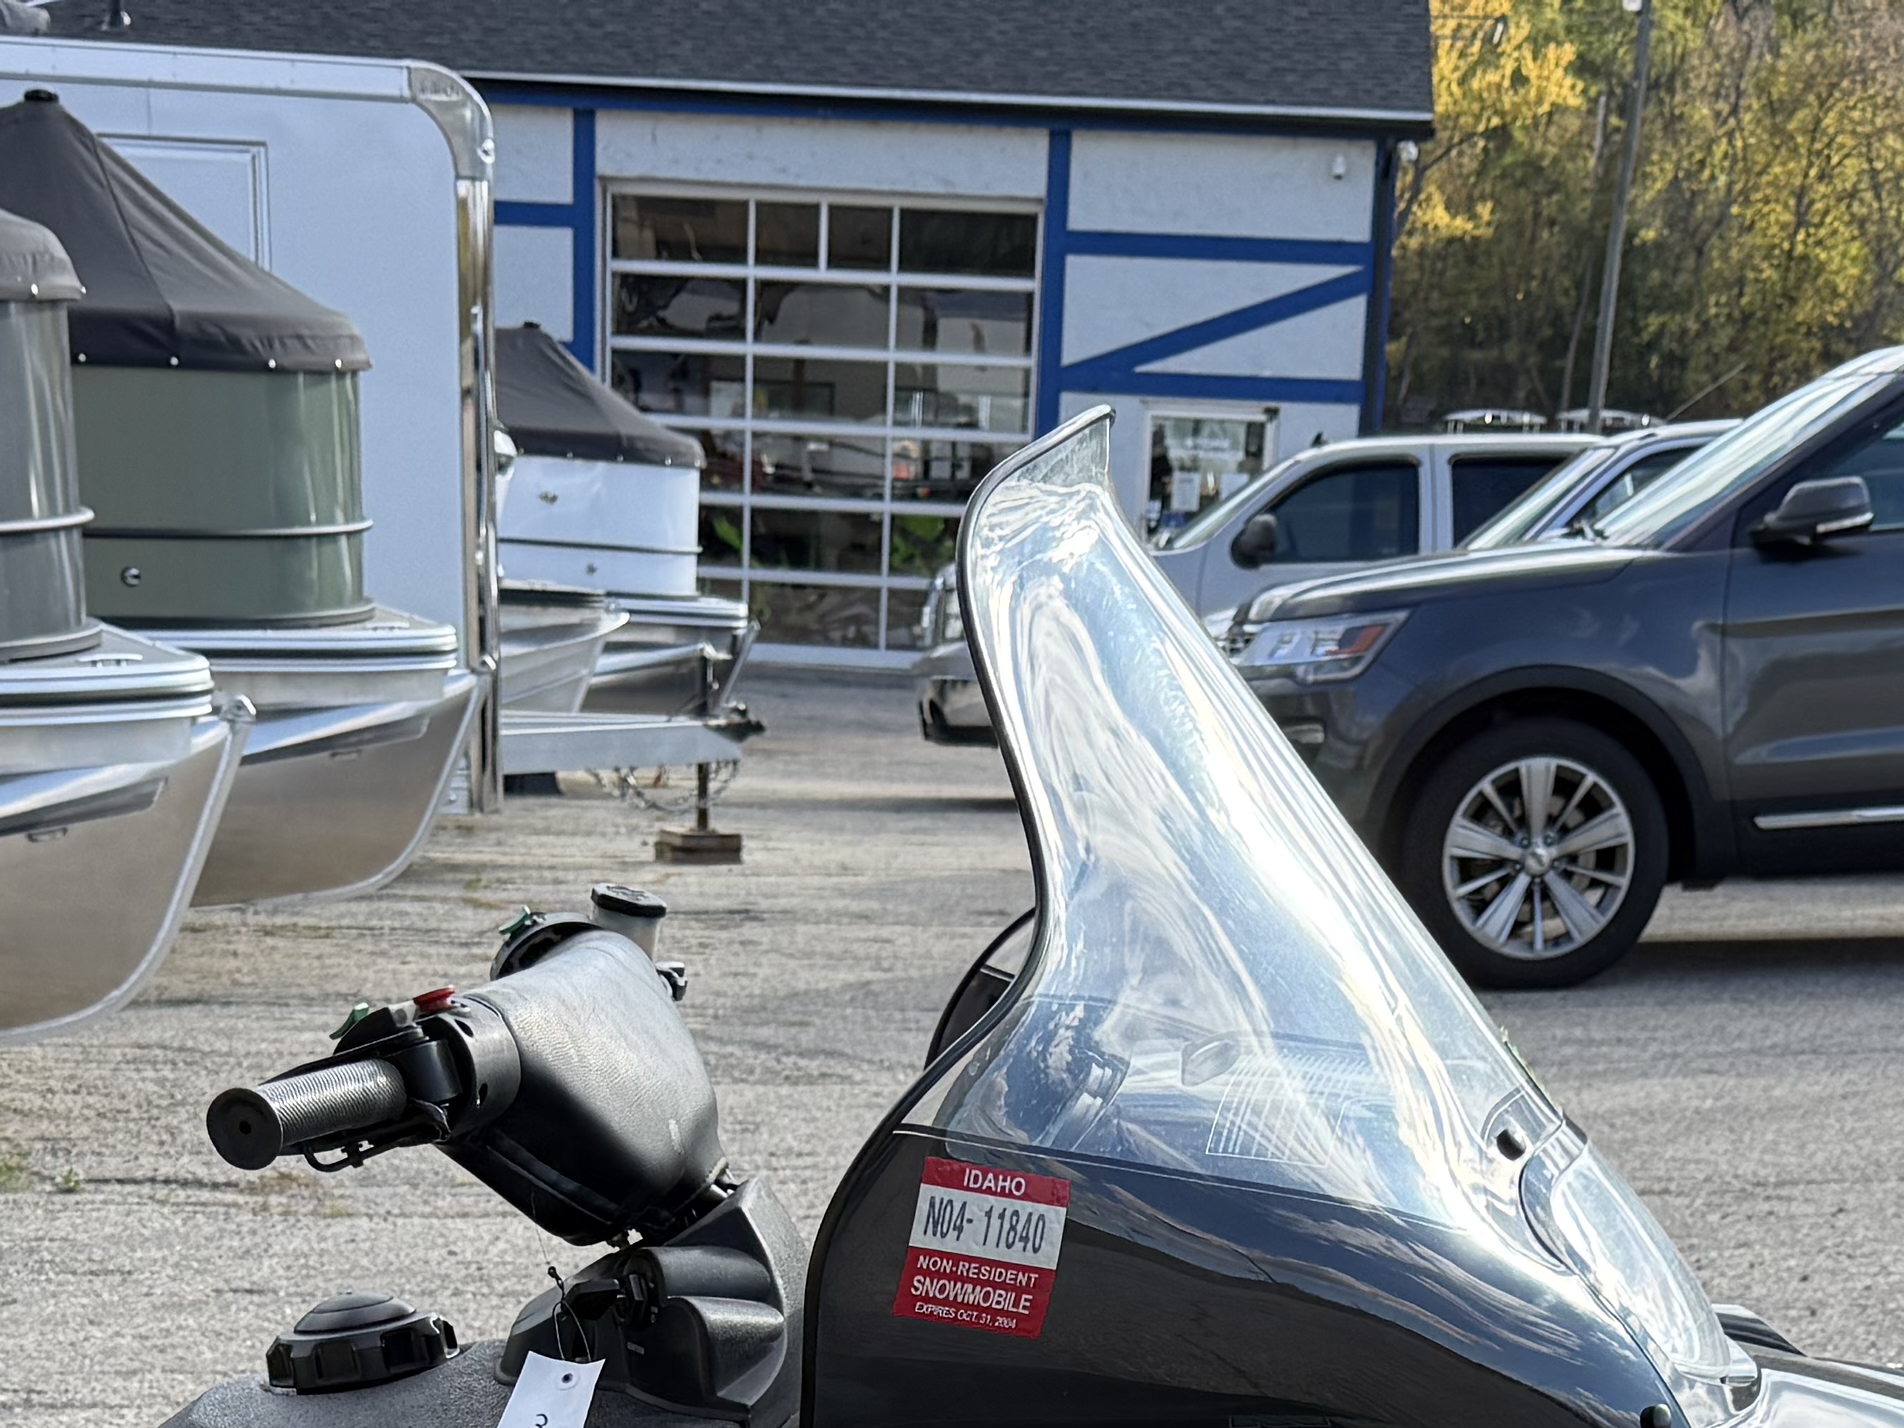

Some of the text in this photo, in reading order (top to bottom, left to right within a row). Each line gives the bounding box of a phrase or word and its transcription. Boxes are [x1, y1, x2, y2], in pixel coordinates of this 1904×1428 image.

[963, 1168, 1026, 1196] IDAHO
[982, 1204, 1047, 1254] 11840
[917, 1254, 1039, 1288] NON-RESIDENT
[911, 1275, 1033, 1315] SNOWMOBILE
[914, 1302, 956, 1319] EXPIRES
[957, 1309, 979, 1323] OCT.
